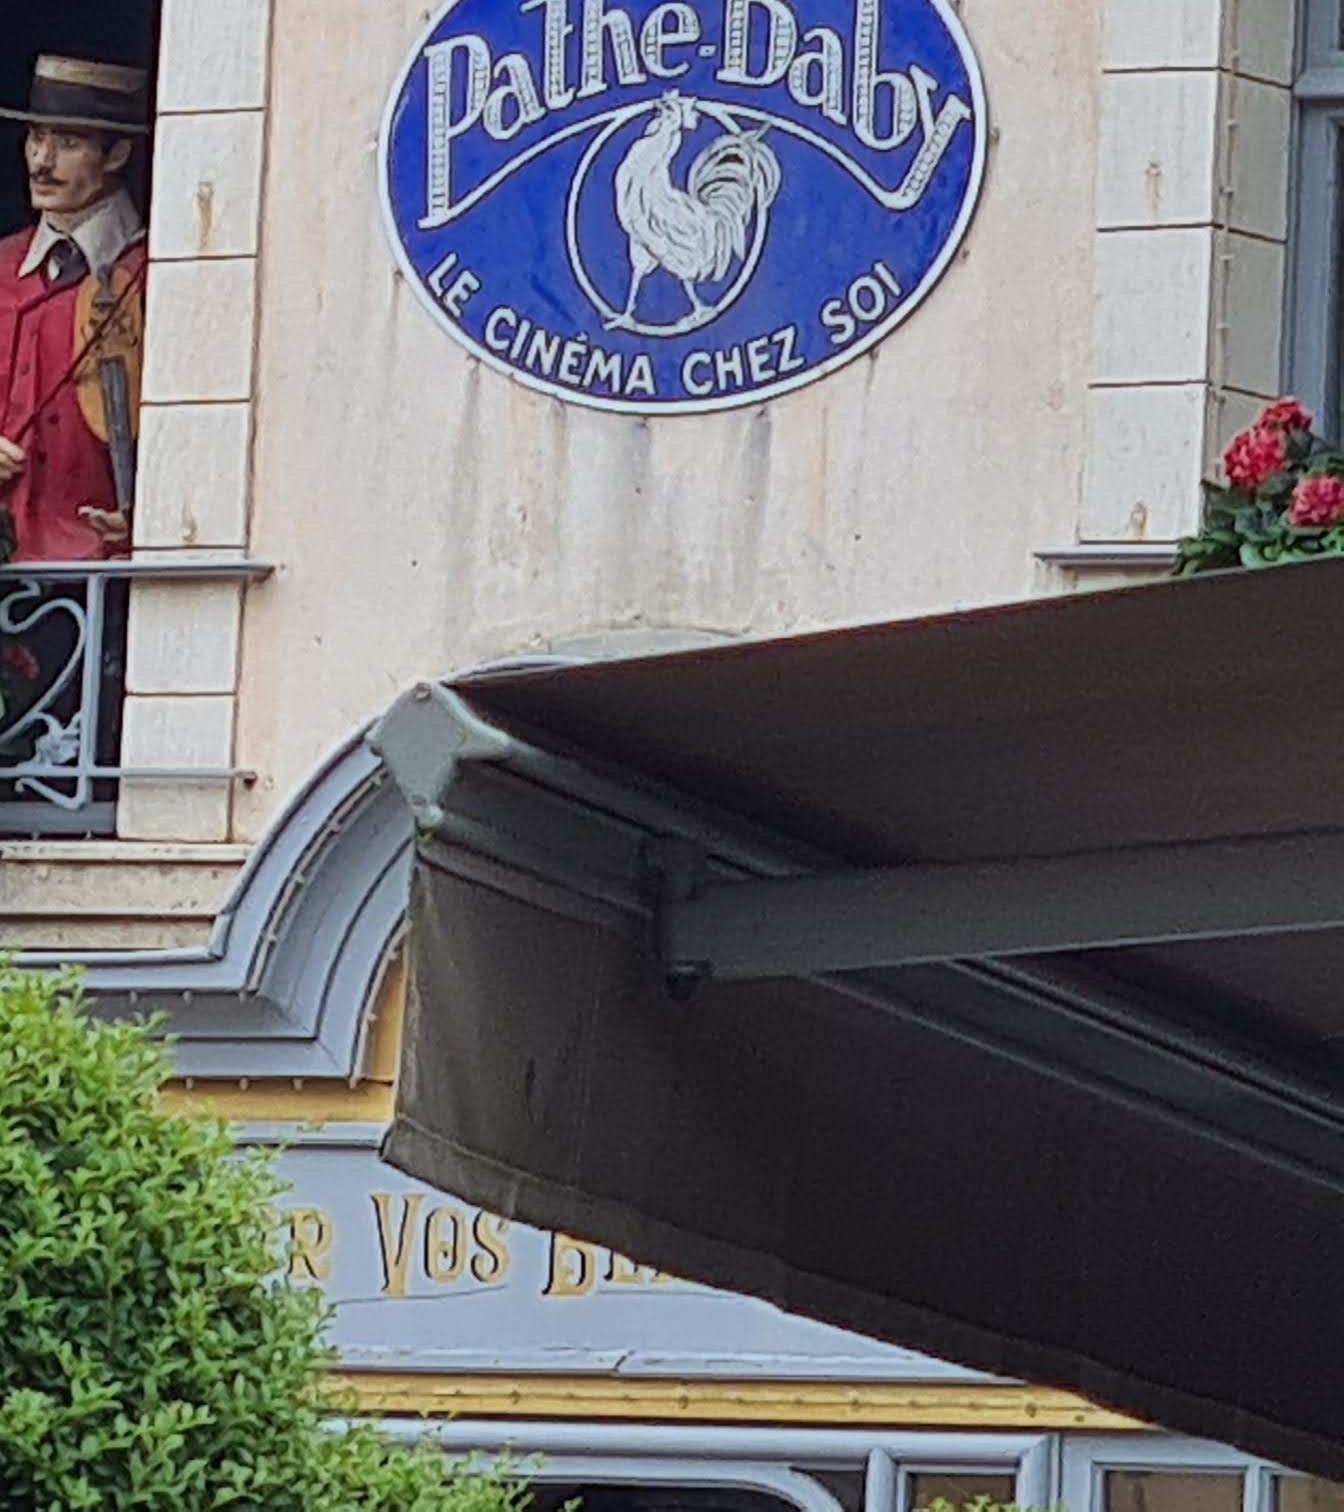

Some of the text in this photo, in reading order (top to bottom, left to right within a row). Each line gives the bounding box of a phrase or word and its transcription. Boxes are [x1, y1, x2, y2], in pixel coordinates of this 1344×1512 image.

[428, 252, 904, 397] LE CINÉMA CHEZ SOI
